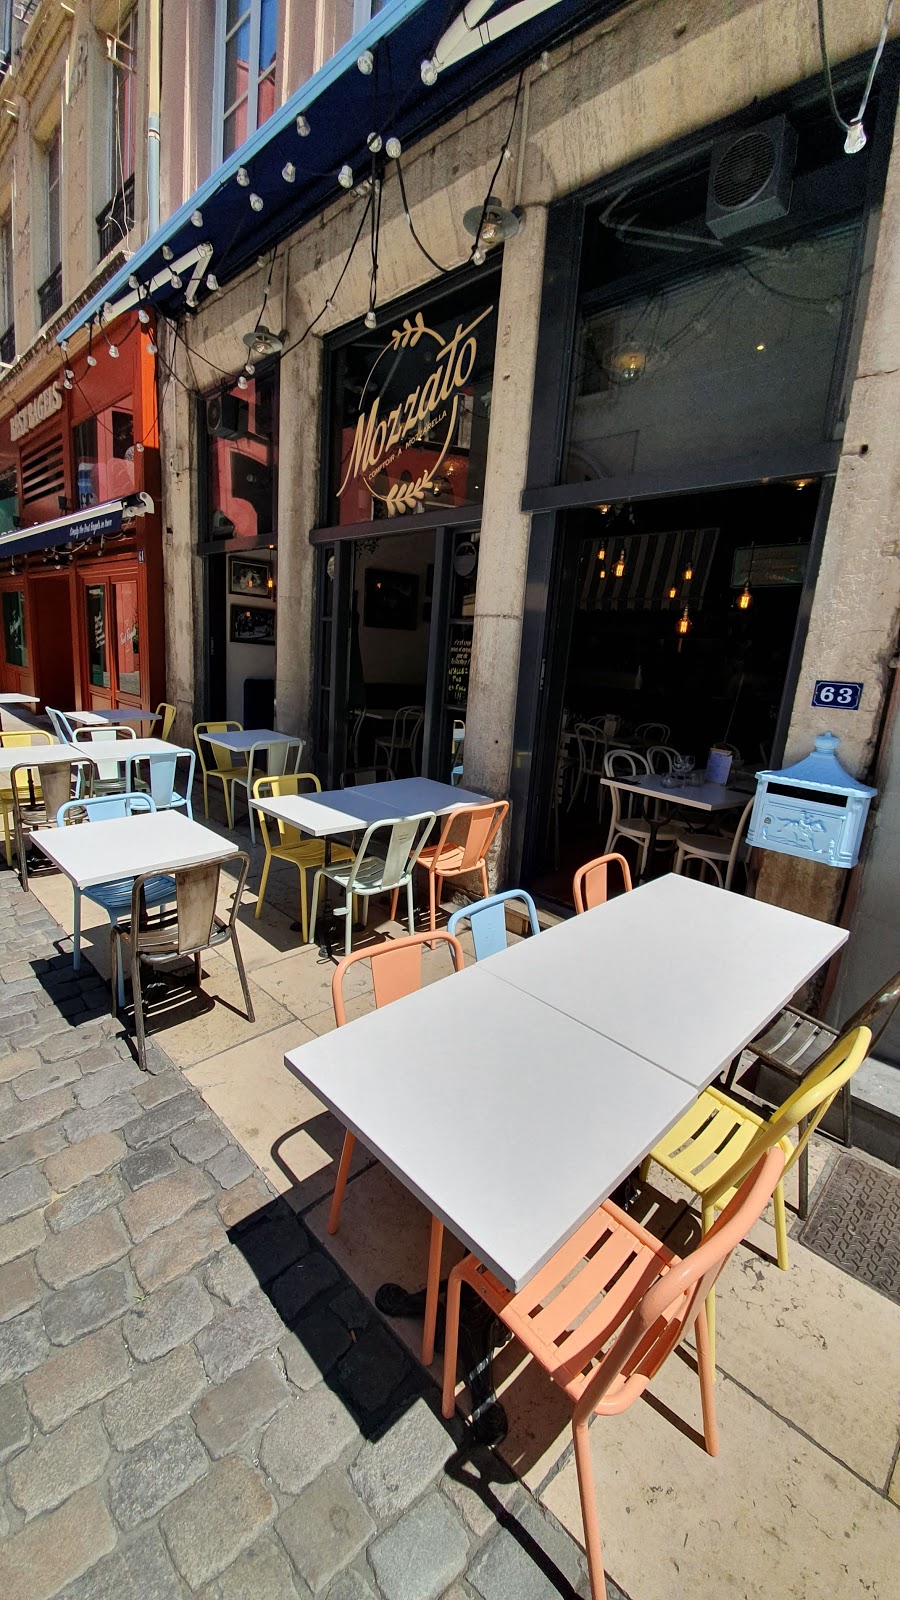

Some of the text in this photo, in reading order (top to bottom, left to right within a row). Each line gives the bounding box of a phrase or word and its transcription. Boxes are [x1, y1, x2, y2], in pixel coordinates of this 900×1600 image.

[28, 380, 63, 429] BAGELS
[336, 304, 494, 498] Mozzato
[368, 454, 395, 480] COMPTOIR
[405, 410, 448, 449] MOZZARELLA
[820, 686, 853, 704] 63
